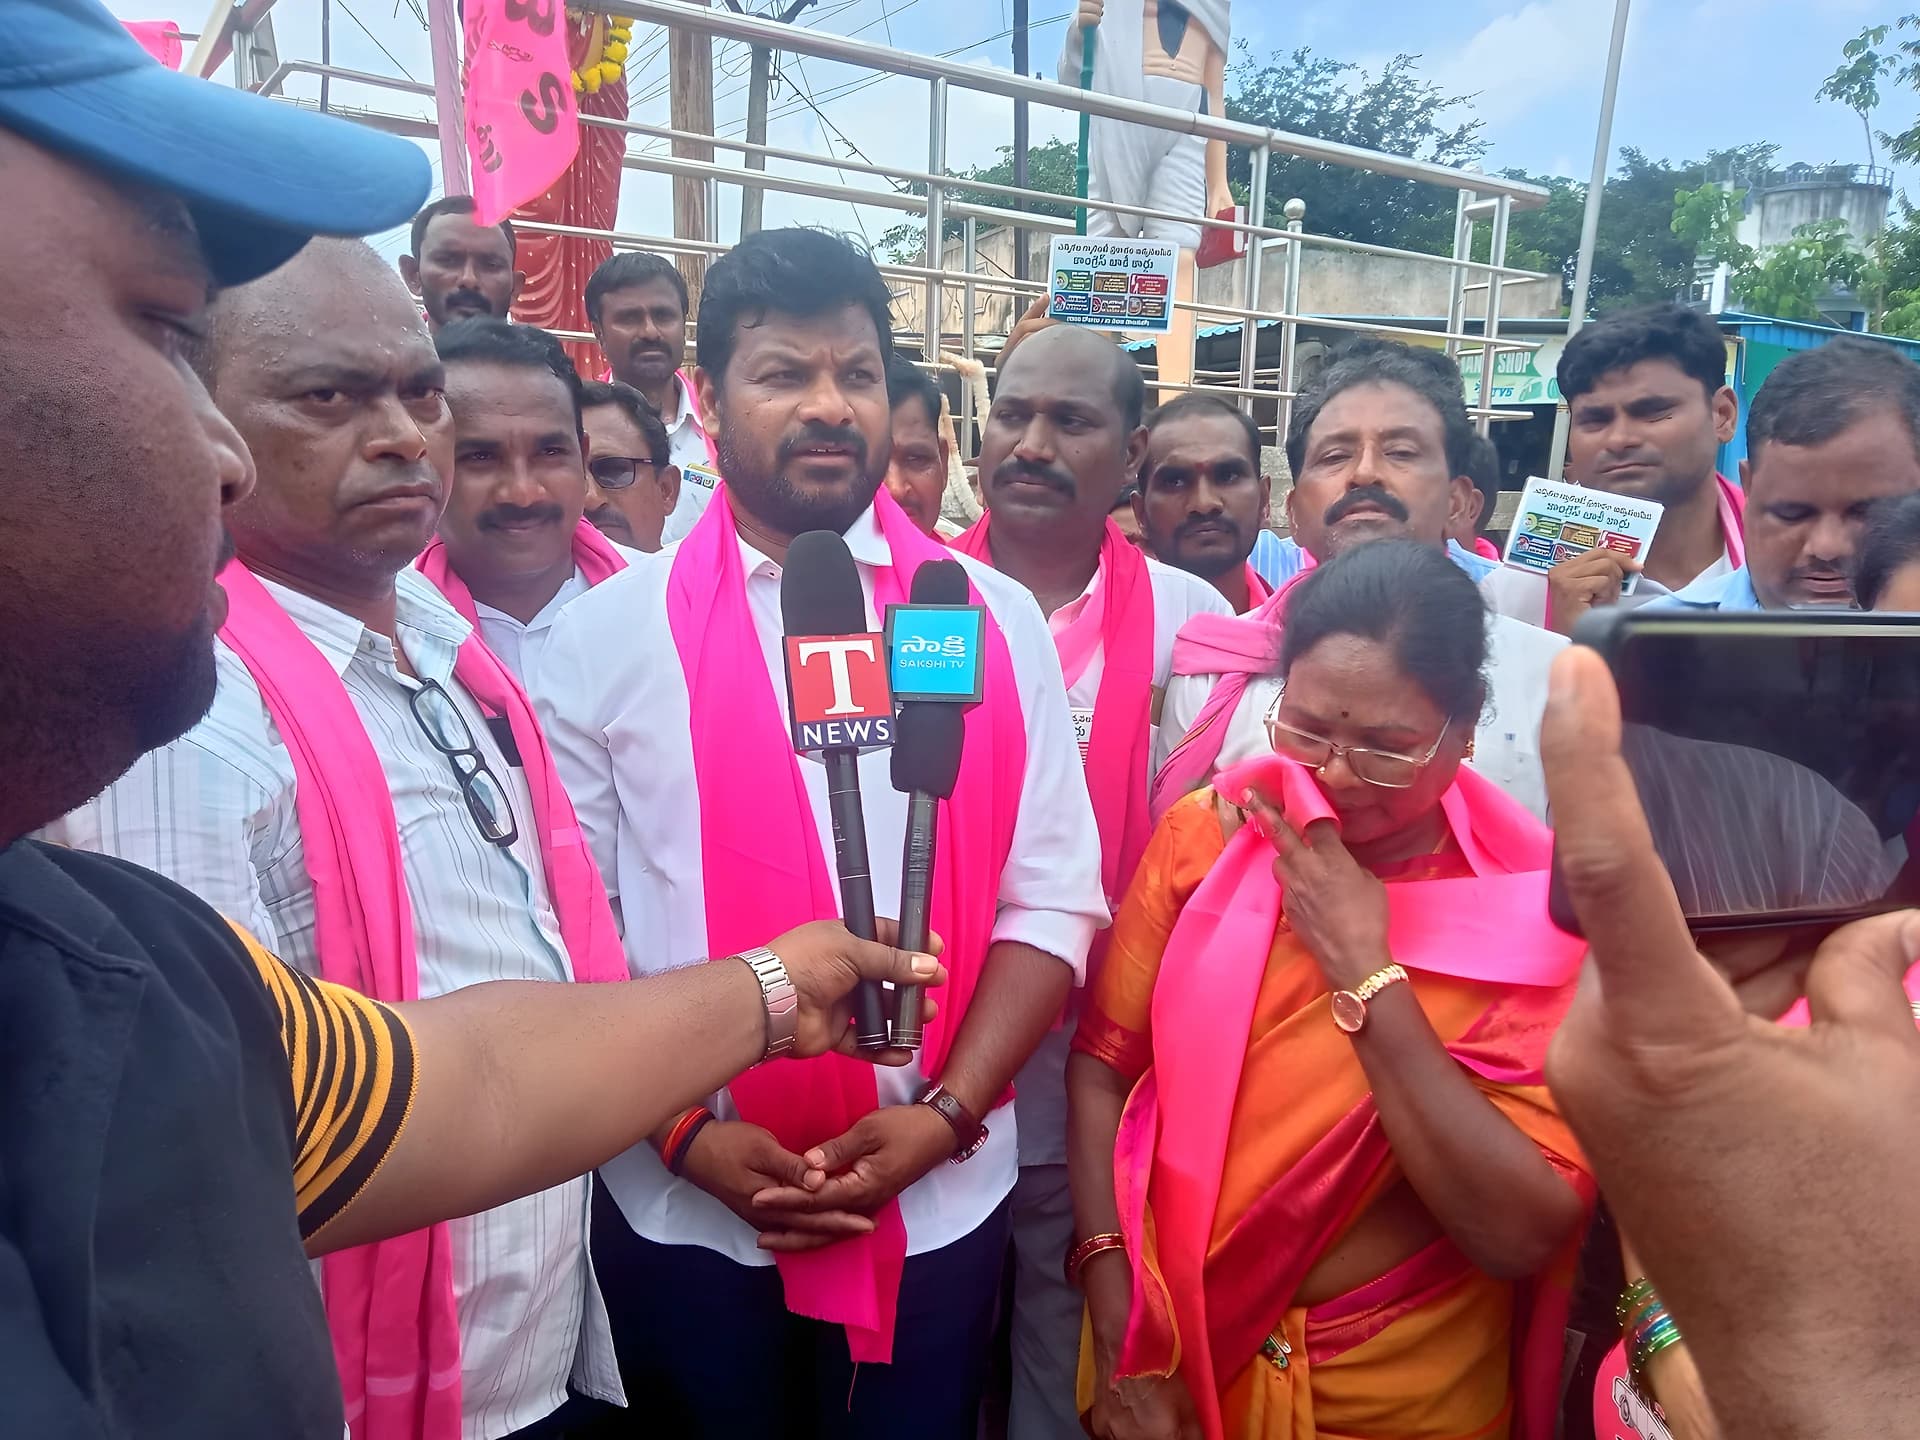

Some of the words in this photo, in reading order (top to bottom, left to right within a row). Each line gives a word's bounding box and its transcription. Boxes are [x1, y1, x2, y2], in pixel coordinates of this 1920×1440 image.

[1497, 351, 1531, 374] SHOP
[900, 635, 966, 657] సాక్షి
[899, 659, 946, 669] SAKSHI
[949, 660, 965, 669] TV
[798, 640, 876, 715] T
[803, 719, 890, 746] NEWS
